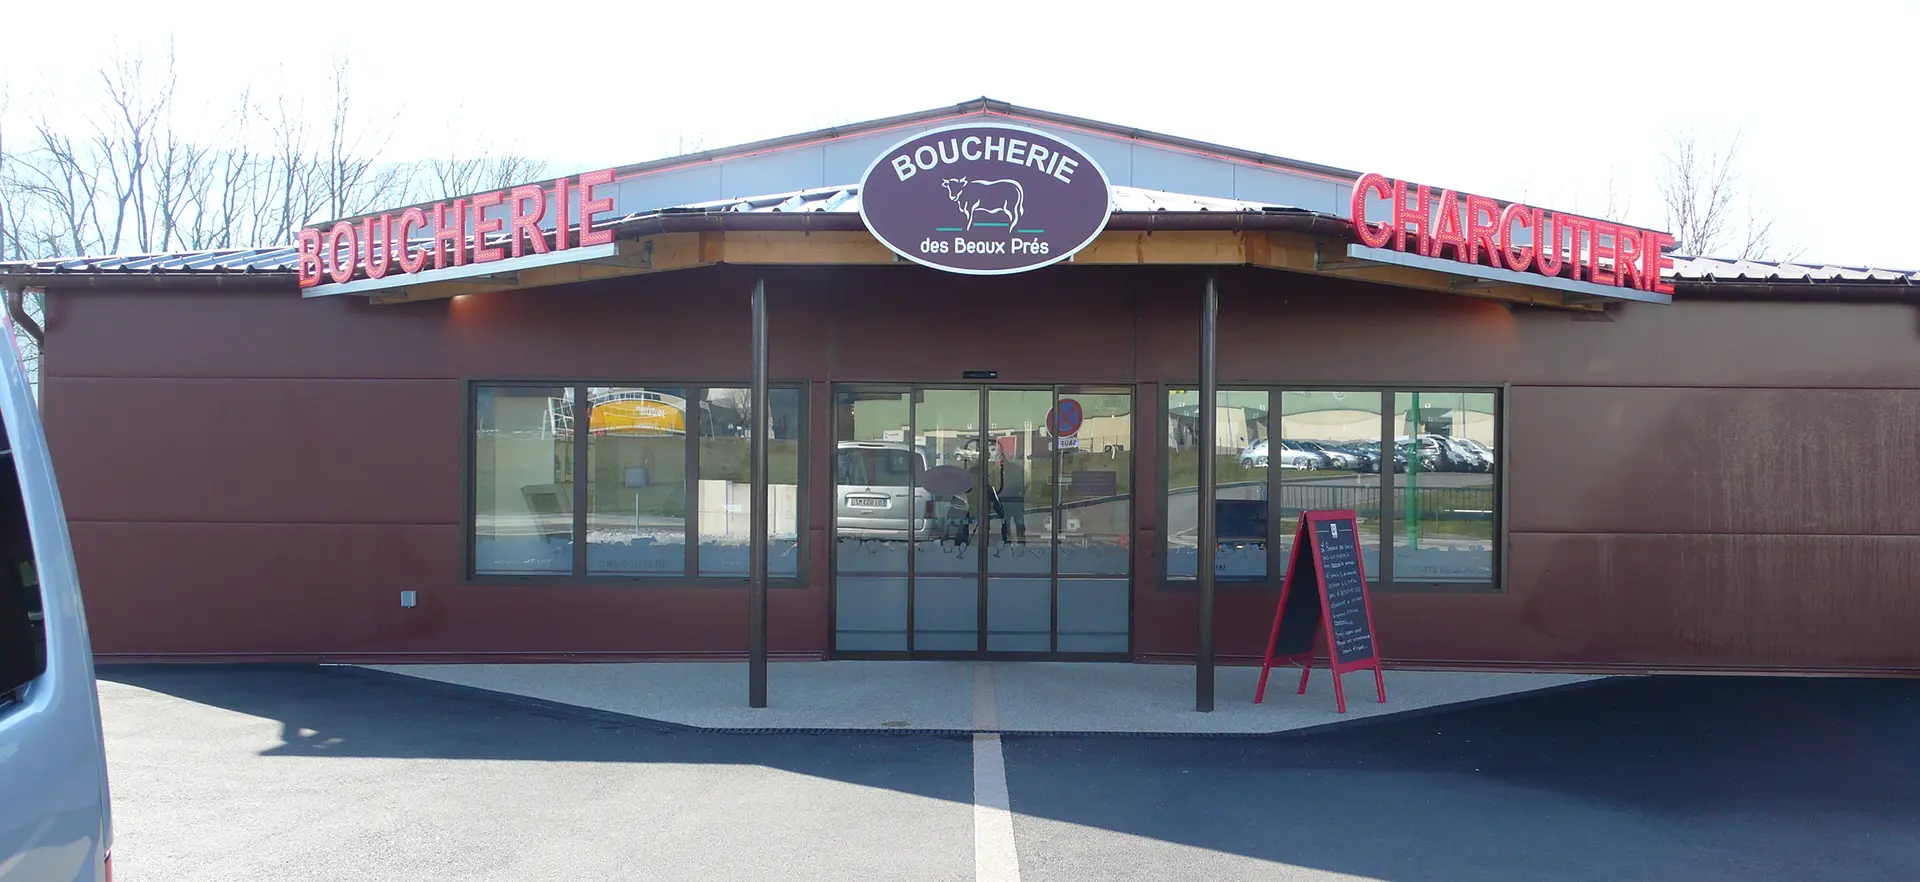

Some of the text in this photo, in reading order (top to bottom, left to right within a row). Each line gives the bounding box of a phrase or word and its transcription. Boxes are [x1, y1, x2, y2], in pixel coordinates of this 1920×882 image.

[891, 136, 1080, 184] BOUCHERIE
[298, 168, 616, 288] BOUCHERIE
[920, 236, 1050, 254] des Beaux Prés
[1351, 172, 1676, 294] CHARCUTERIE
